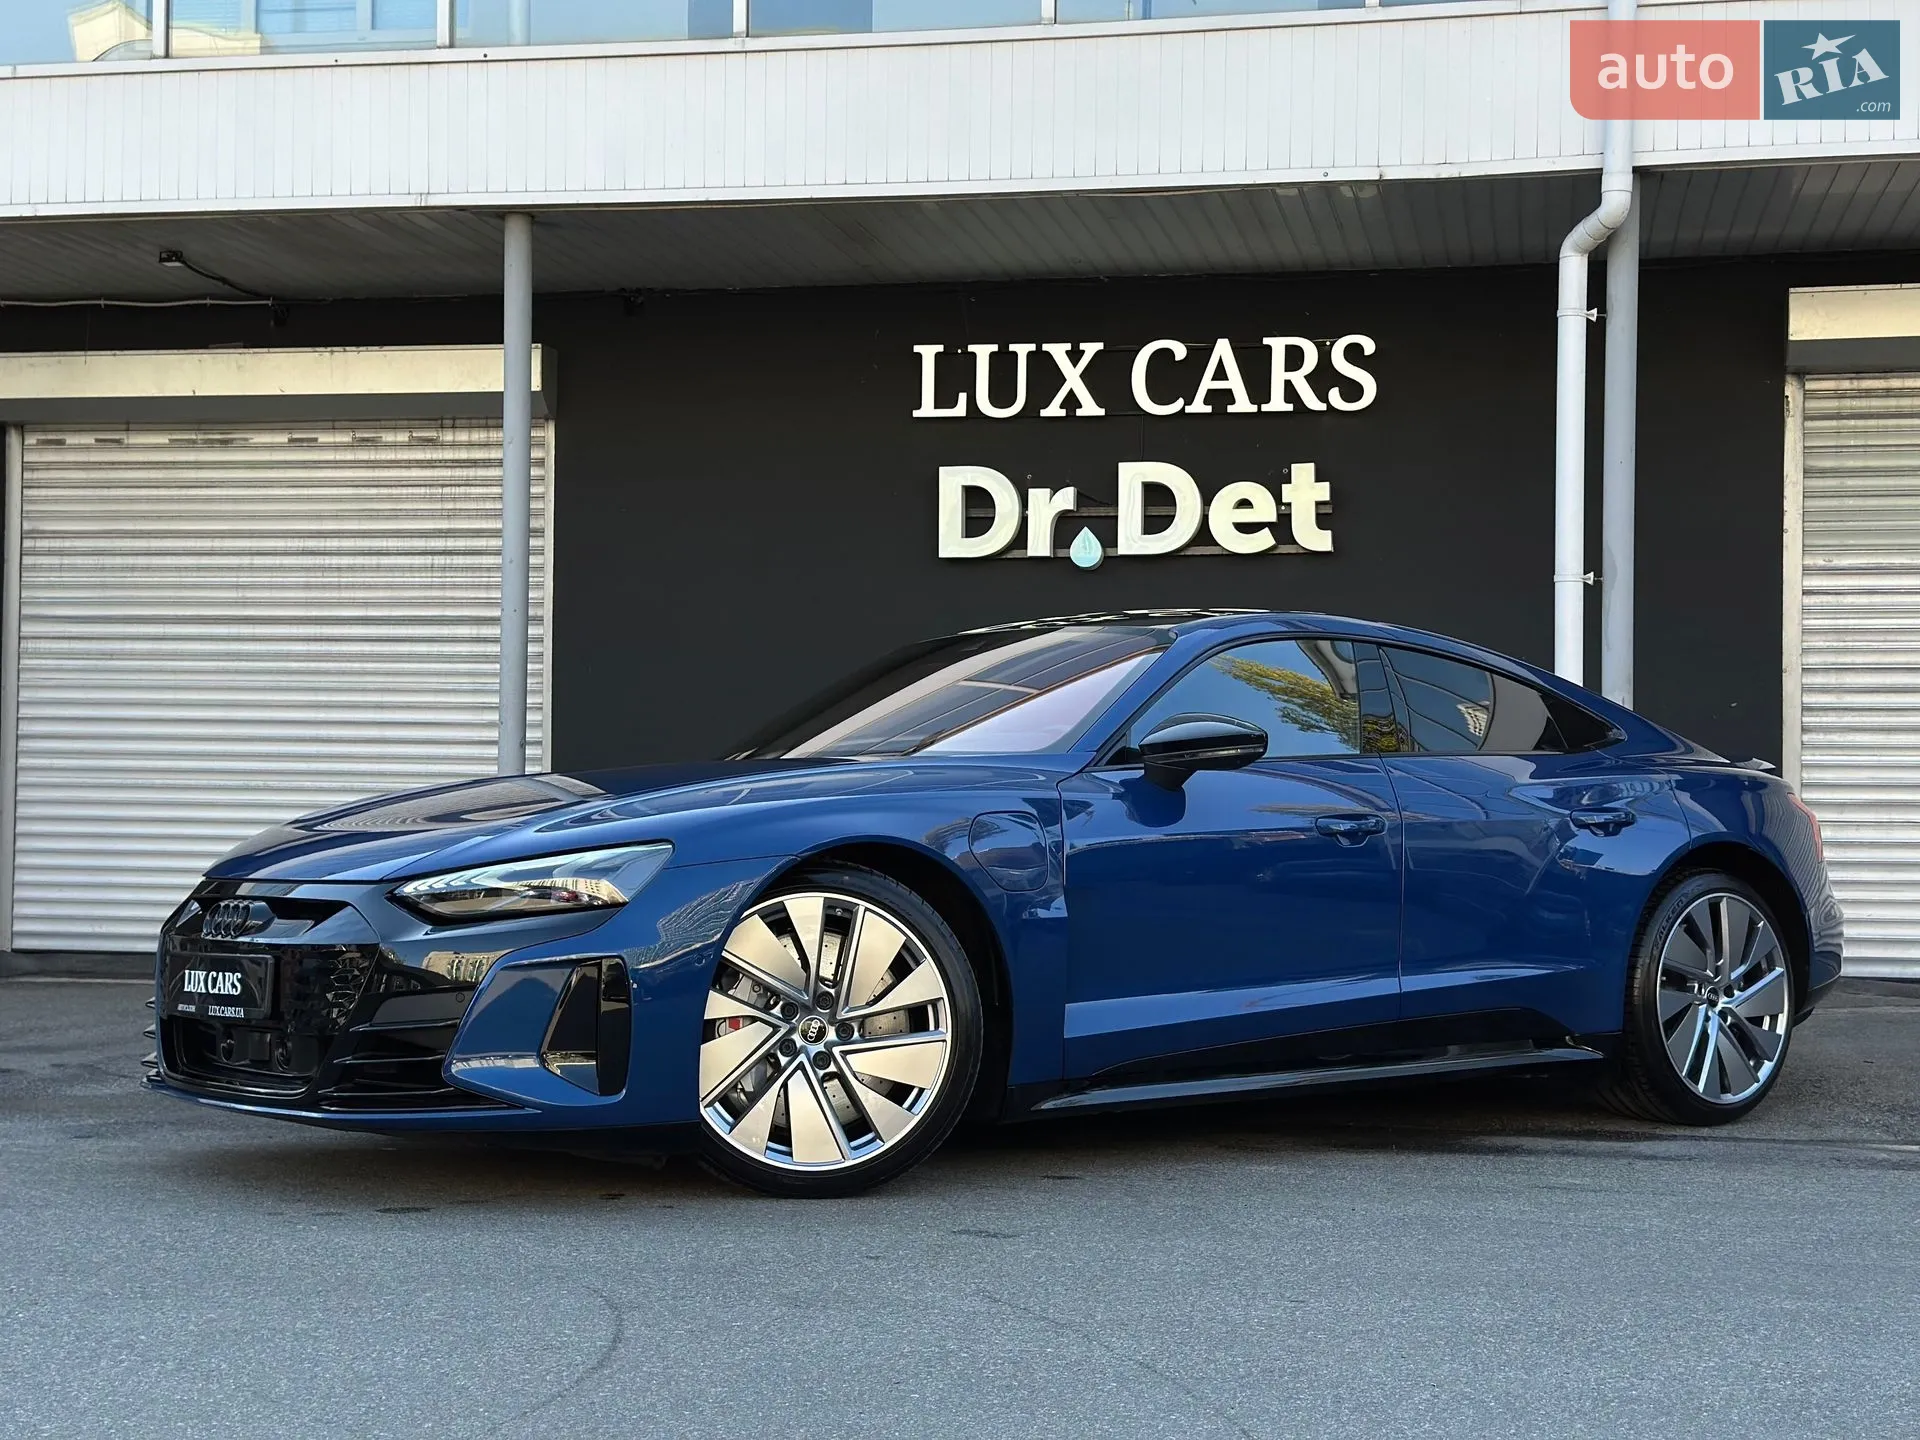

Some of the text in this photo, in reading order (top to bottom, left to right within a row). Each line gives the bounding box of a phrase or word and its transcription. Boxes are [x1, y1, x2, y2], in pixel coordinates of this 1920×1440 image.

[912, 334, 1377, 418] LUX CARS
[183, 969, 242, 995] LUX CARS
